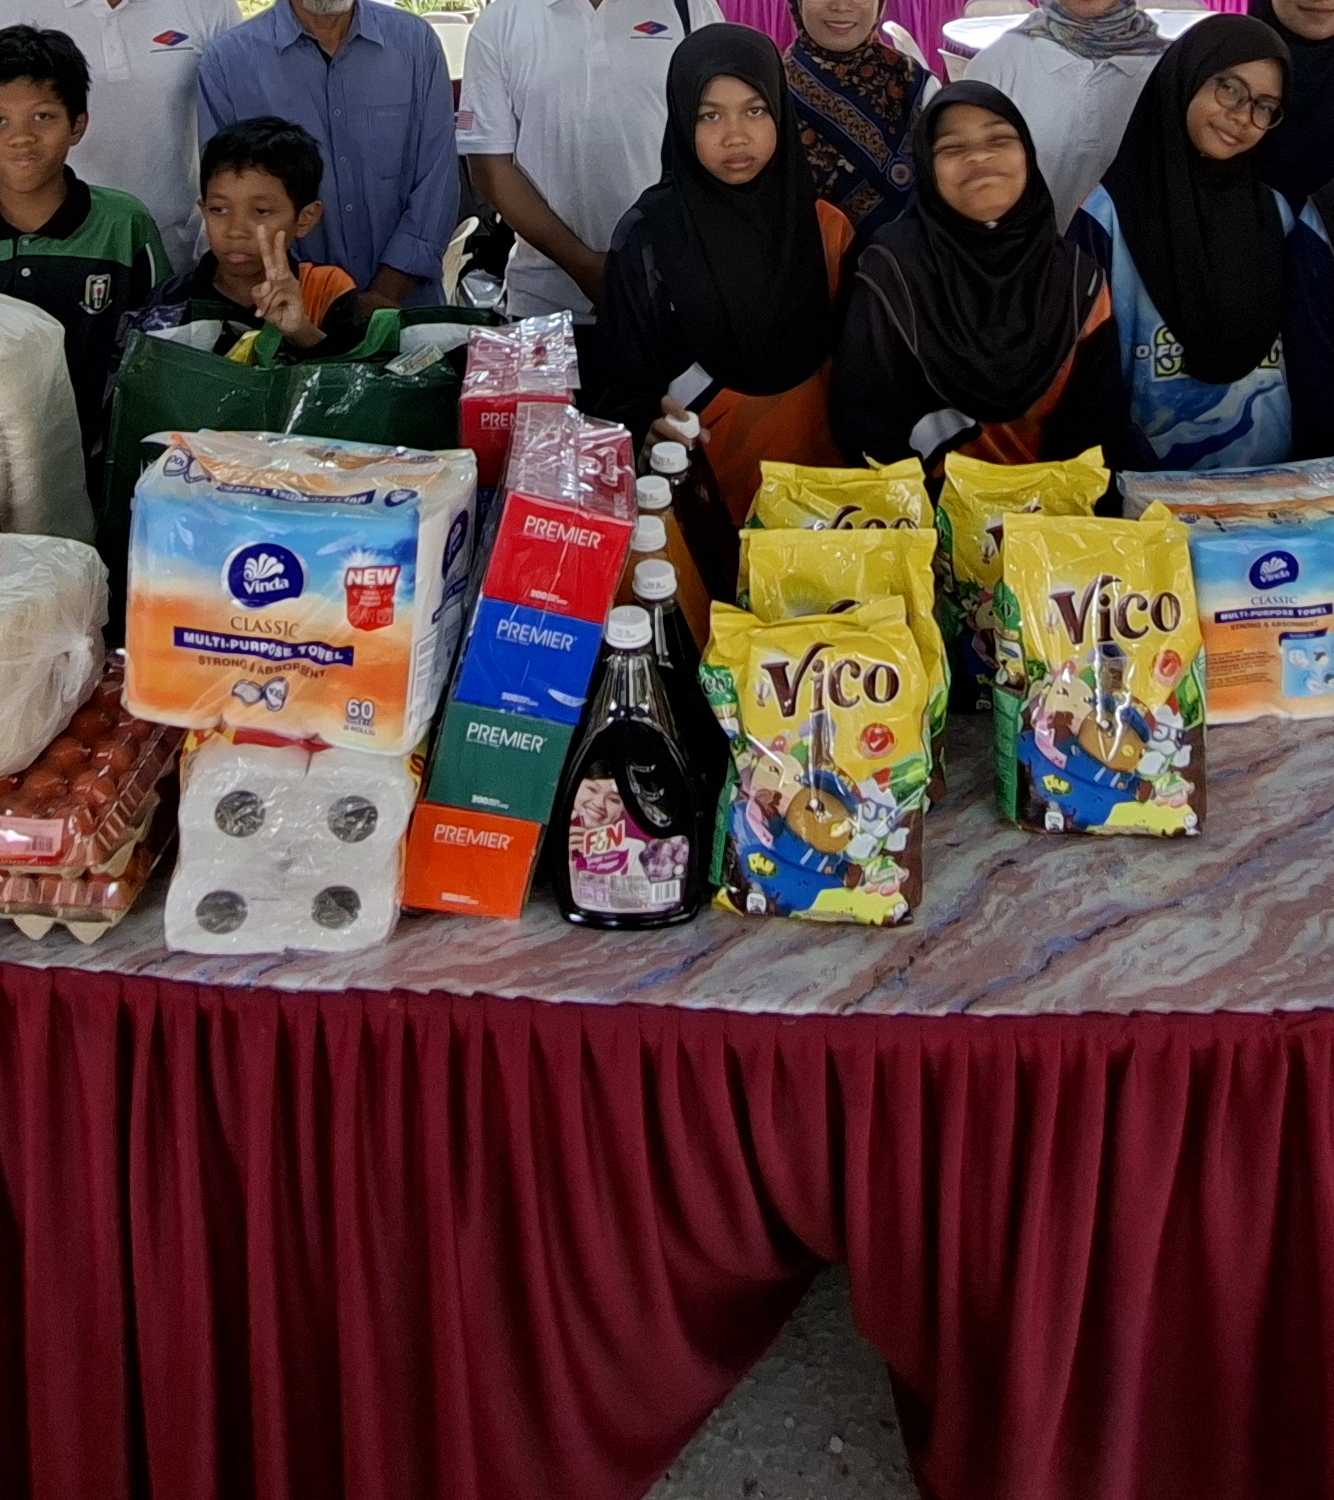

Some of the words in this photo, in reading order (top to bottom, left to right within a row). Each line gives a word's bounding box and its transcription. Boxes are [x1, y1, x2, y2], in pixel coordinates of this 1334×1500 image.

[524, 515, 603, 550] PREMIER
[243, 578, 291, 595] Vinda
[347, 566, 399, 586] NEW
[1049, 573, 1181, 645] Vico
[1251, 595, 1299, 606] CLASSIC
[1220, 608, 1295, 622] MULTI-PURPOSE
[1297, 606, 1328, 617] TOWEL
[1230, 621, 1261, 631] STRONG
[230, 616, 300, 639] CLASSIC
[496, 619, 576, 652] PREMIER
[183, 631, 293, 658] MULTI-PURPOSE
[297, 644, 345, 662] TOWEL
[198, 655, 248, 670] STRONG
[761, 641, 900, 718] Vico
[347, 698, 374, 720] 60
[467, 721, 545, 754] PREMIER
[433, 823, 512, 851] PREMIER
[583, 820, 625, 858] F&N
